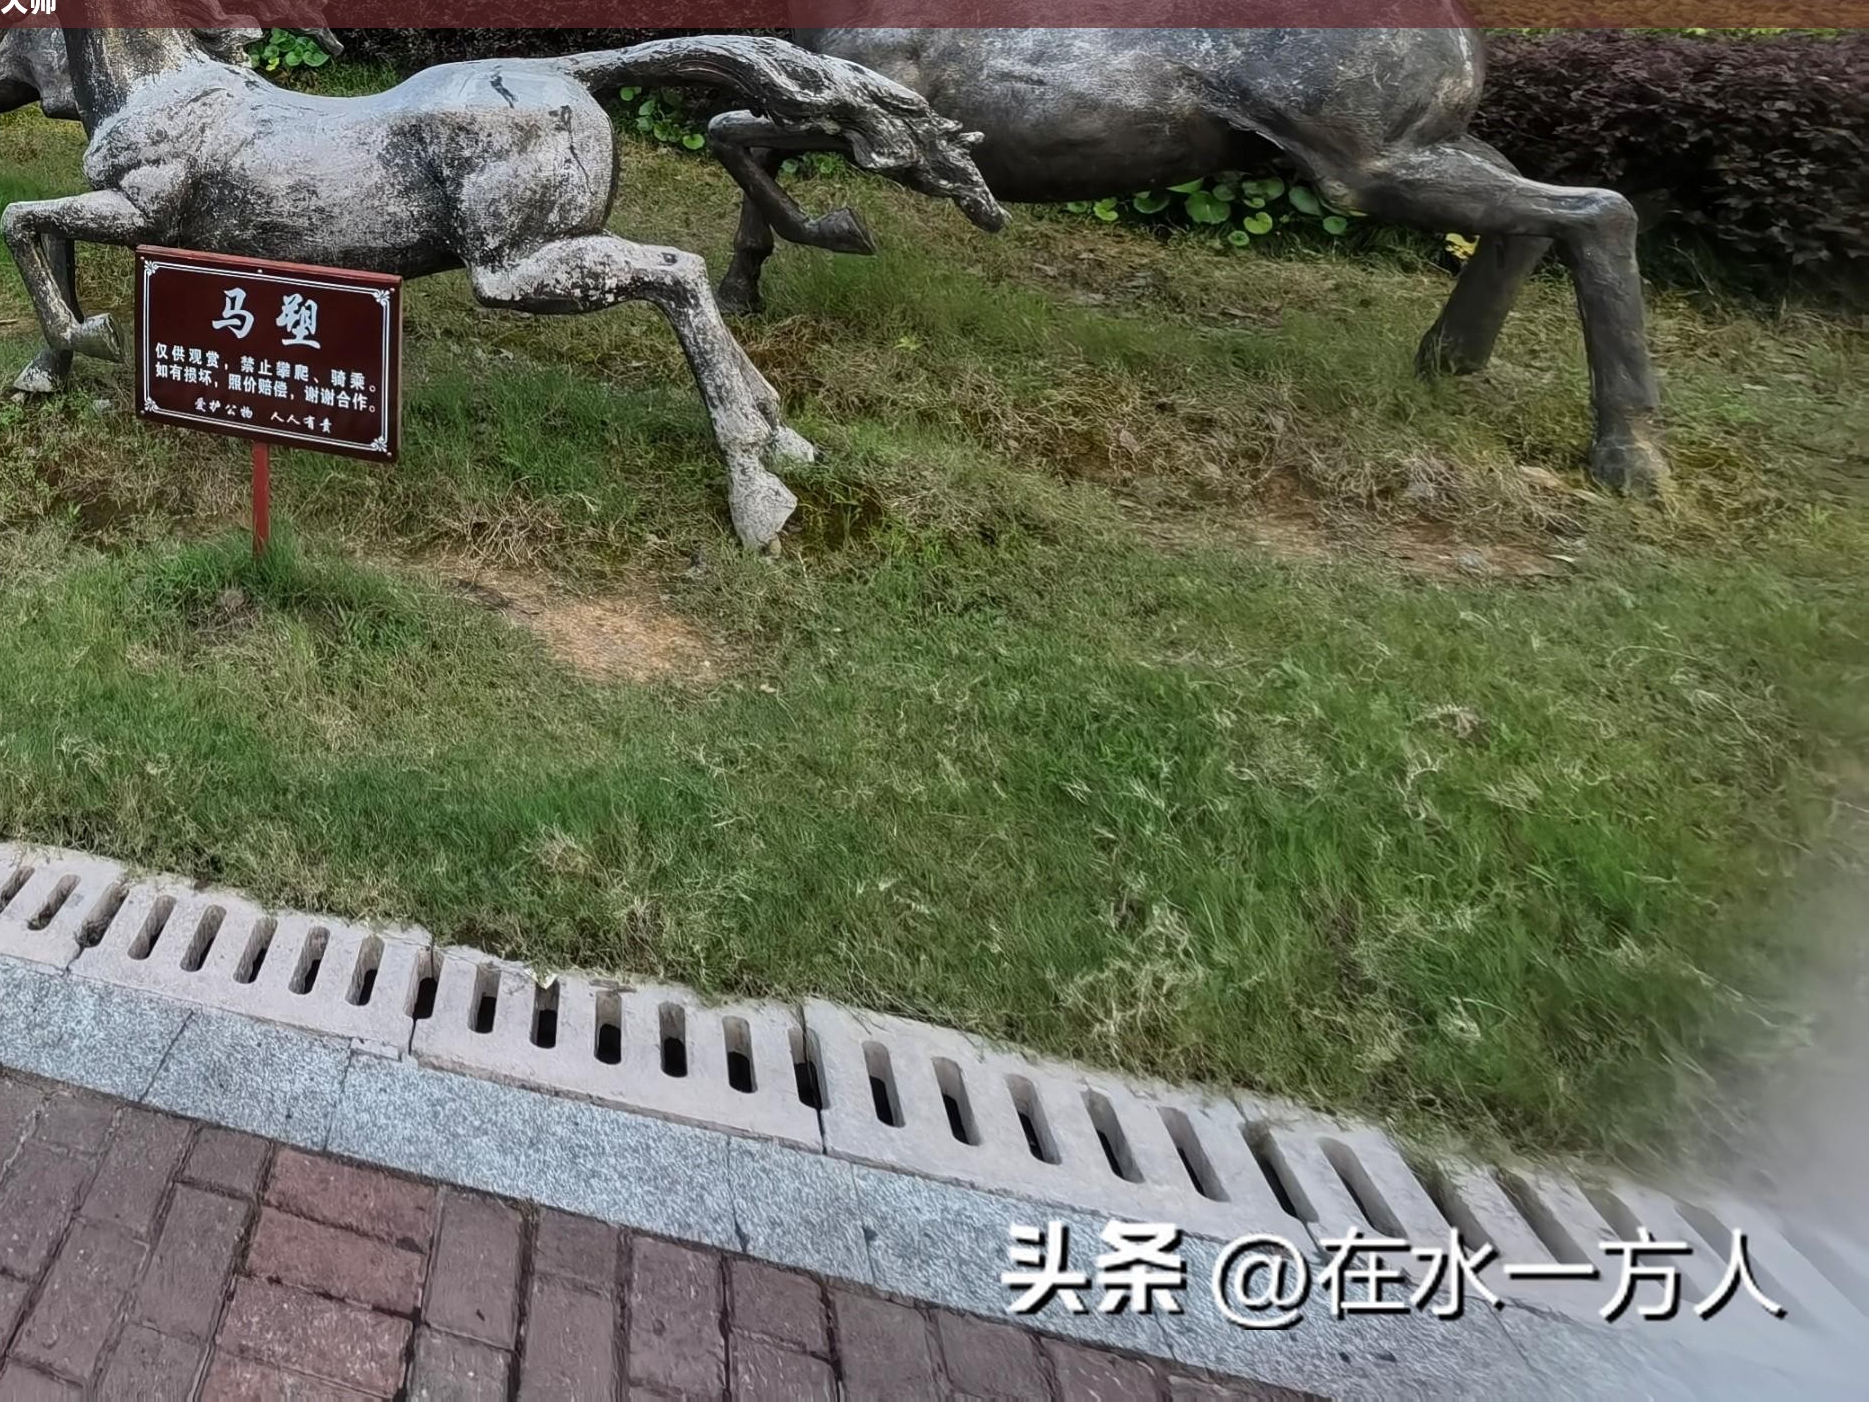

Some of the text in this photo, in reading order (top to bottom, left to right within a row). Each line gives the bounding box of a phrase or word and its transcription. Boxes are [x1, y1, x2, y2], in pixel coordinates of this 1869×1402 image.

[211, 286, 322, 350] 马塑
[194, 396, 333, 435] 爱护公物 人人有责
